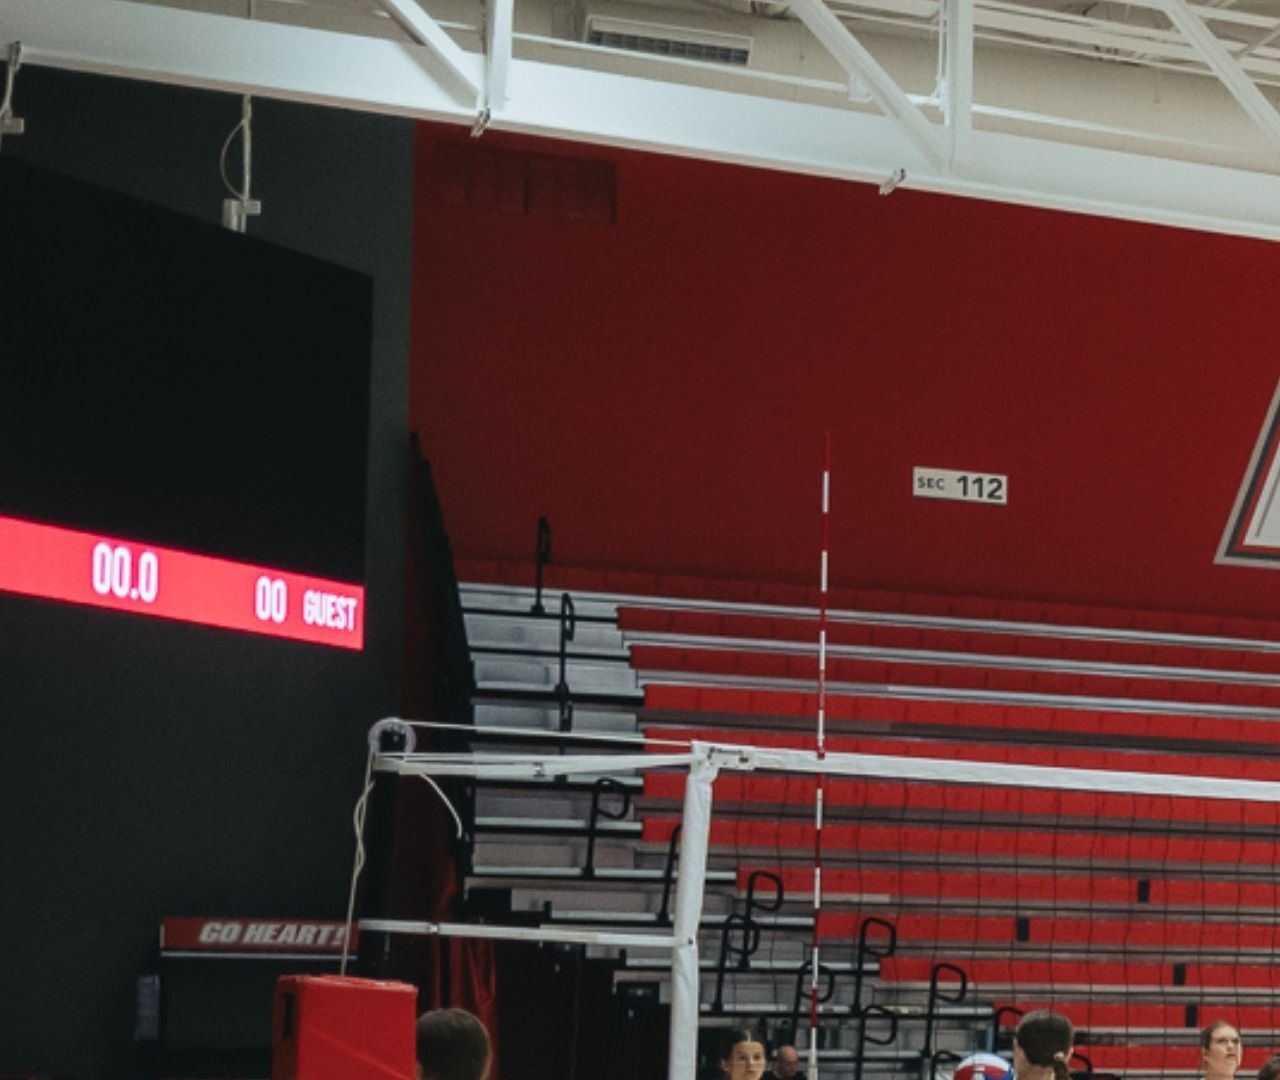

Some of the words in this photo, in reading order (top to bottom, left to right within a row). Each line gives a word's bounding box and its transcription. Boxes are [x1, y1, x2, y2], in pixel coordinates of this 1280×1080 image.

[917, 476, 945, 490] SEC
[957, 475, 1003, 500] 112
[92, 542, 159, 603] 00.0
[255, 576, 288, 623] 00
[303, 590, 357, 632] GUEST
[200, 922, 241, 943] GO
